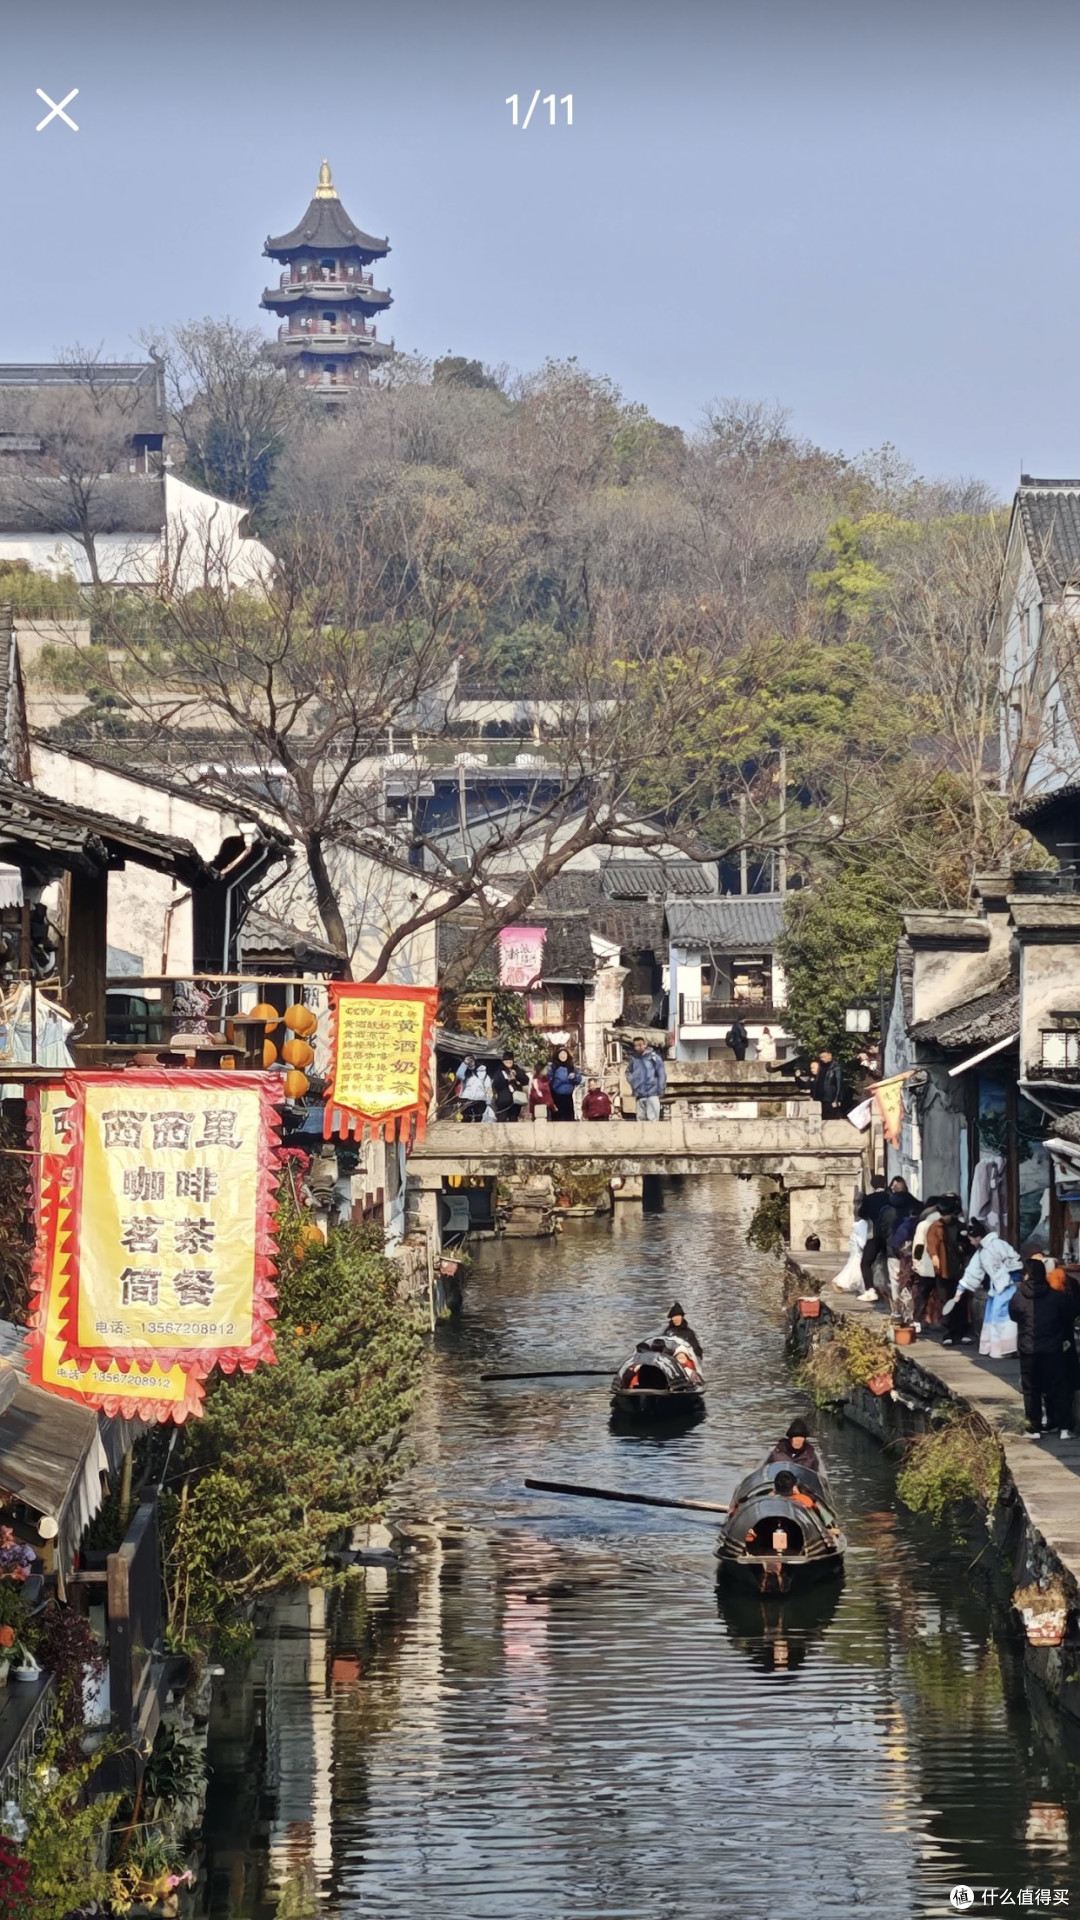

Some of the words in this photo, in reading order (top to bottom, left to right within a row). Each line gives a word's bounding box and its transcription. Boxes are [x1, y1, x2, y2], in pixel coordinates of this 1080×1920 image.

[101, 1109, 243, 1151] 西西里
[123, 1166, 218, 1203] 咖啡
[120, 1216, 216, 1254] 茗茶
[141, 1322, 234, 1335] 13567208912
[92, 1371, 171, 1388] 13567208912
